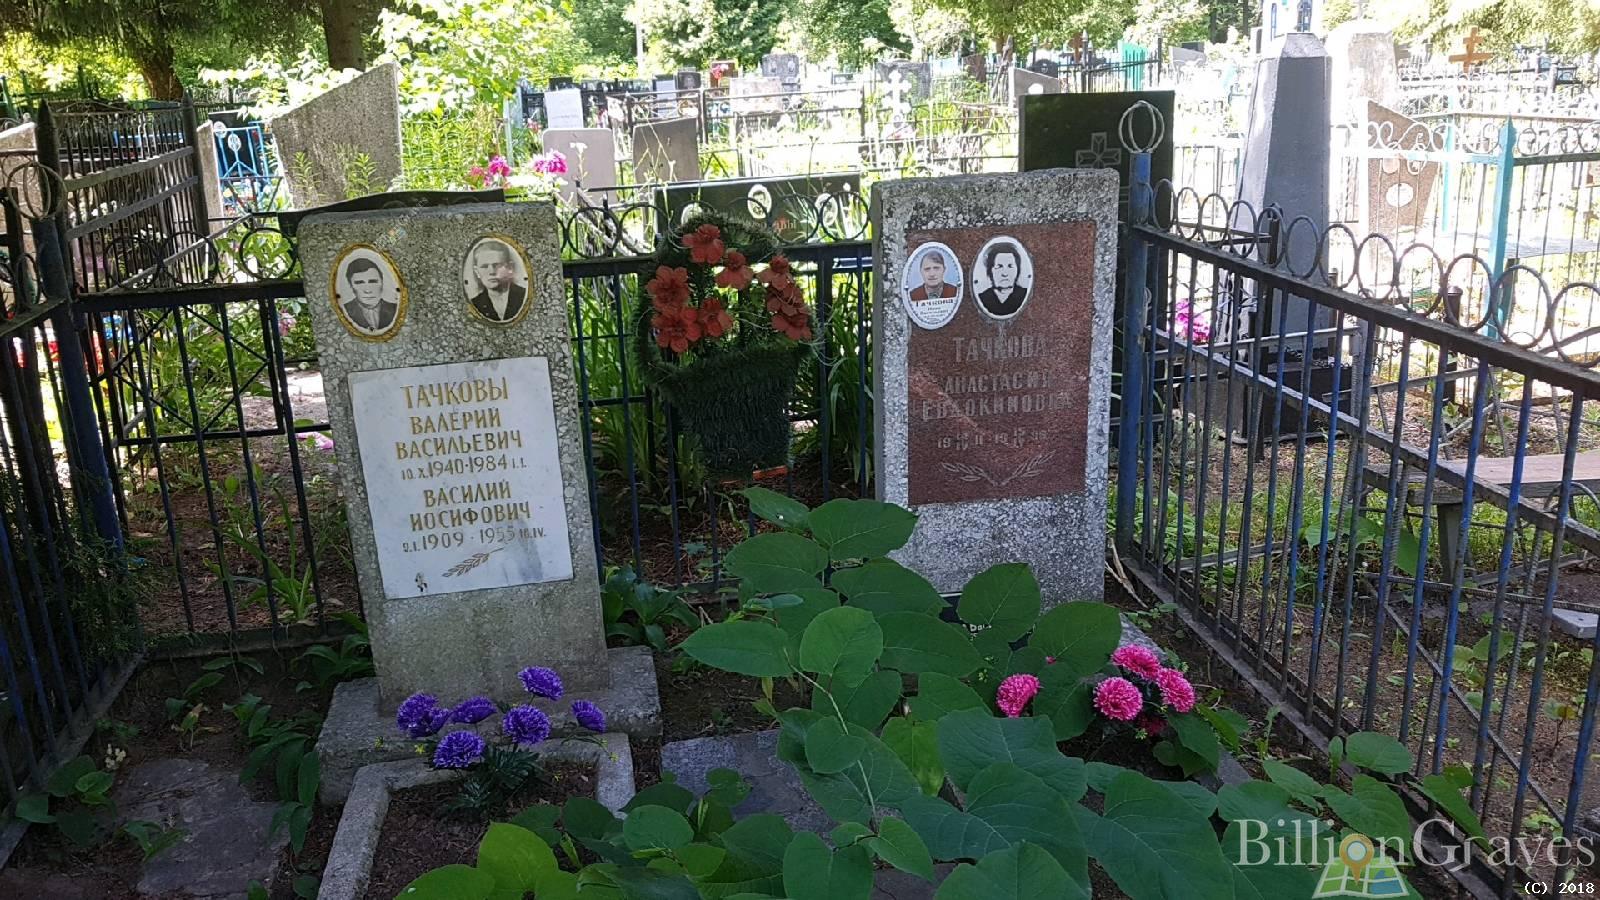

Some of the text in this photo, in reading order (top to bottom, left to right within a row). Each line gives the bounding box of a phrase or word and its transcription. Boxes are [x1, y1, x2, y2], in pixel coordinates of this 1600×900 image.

[400, 377, 508, 409] ТАЧКОВЫ
[410, 406, 501, 435] ВАЛЕРИЙ
[395, 430, 522, 460] ВАСИЛЬЕВИЧ
[424, 478, 512, 507] ВАСИЛИЙ
[410, 501, 531, 532] ИОСИФОВИЧ
[422, 531, 464, 551] 1909
